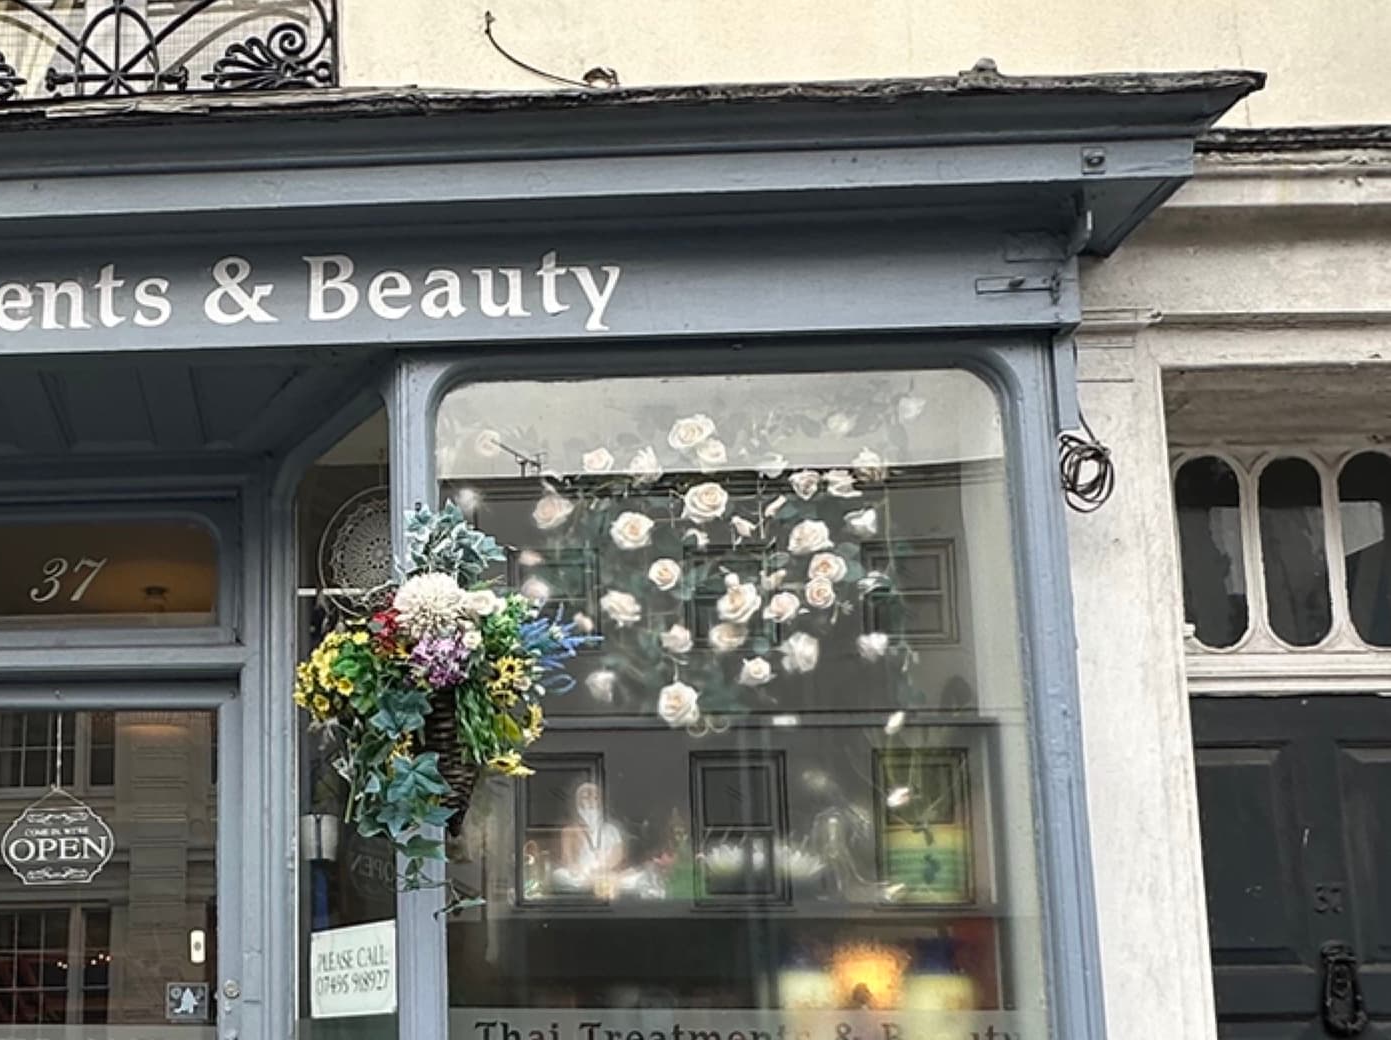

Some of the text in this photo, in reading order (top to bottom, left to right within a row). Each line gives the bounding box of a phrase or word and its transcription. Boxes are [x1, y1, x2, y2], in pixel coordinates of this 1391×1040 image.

[203, 255, 279, 326] &
[302, 250, 622, 332] Beauty
[29, 557, 108, 603] 37
[8, 835, 108, 862] OPEN
